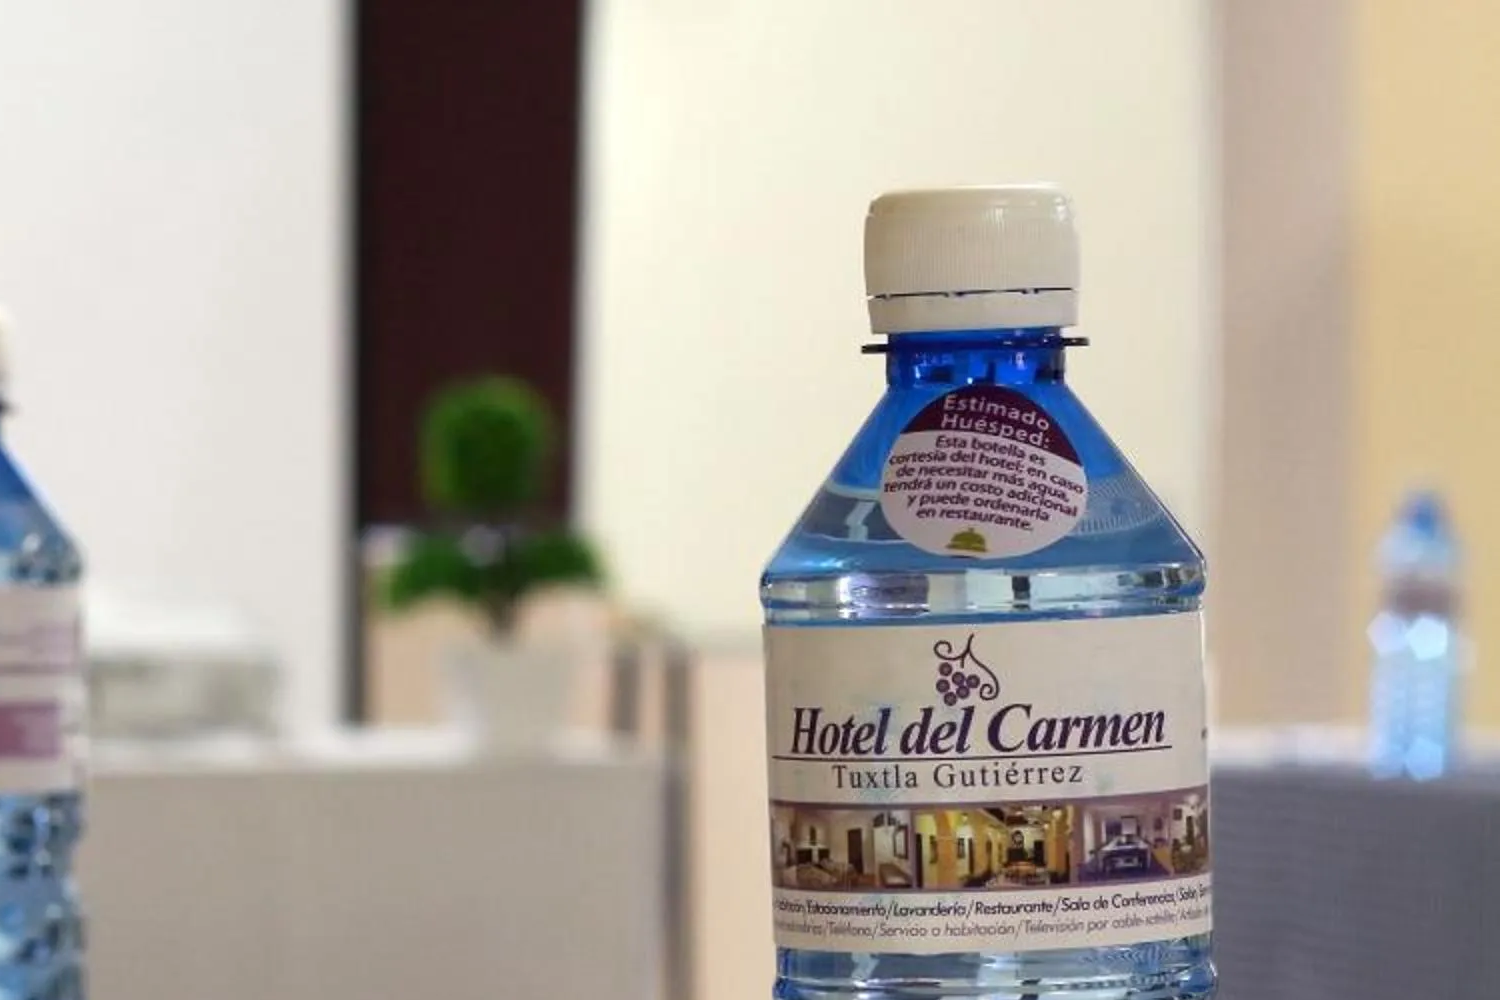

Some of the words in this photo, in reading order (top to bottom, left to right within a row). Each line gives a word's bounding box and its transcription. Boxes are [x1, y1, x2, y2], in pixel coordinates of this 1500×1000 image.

[943, 394, 1049, 431] Estimado
[941, 413, 1050, 448] Huésped:
[936, 435, 967, 449] Esta
[971, 438, 1025, 458] botella
[1029, 454, 1045, 466] es
[889, 450, 947, 465] cortesía
[950, 450, 976, 463] del
[1027, 467, 1046, 479] en
[1050, 475, 1084, 494] caso
[896, 465, 915, 478] de
[918, 466, 988, 479] necesitar
[992, 472, 1024, 486] más
[907, 494, 916, 508] y
[919, 492, 970, 507] puede
[973, 497, 1049, 521] ordenarla
[916, 508, 936, 518] en
[936, 480, 956, 490] un
[960, 482, 1003, 496] costo
[1007, 489, 1078, 516] adicional
[791, 707, 891, 755] Hotel
[900, 704, 974, 754] del
[987, 703, 1166, 753] Carmen
[832, 764, 918, 790] Tuxtla
[933, 760, 1084, 788] Gutiérrez
[1093, 893, 1109, 909] de
